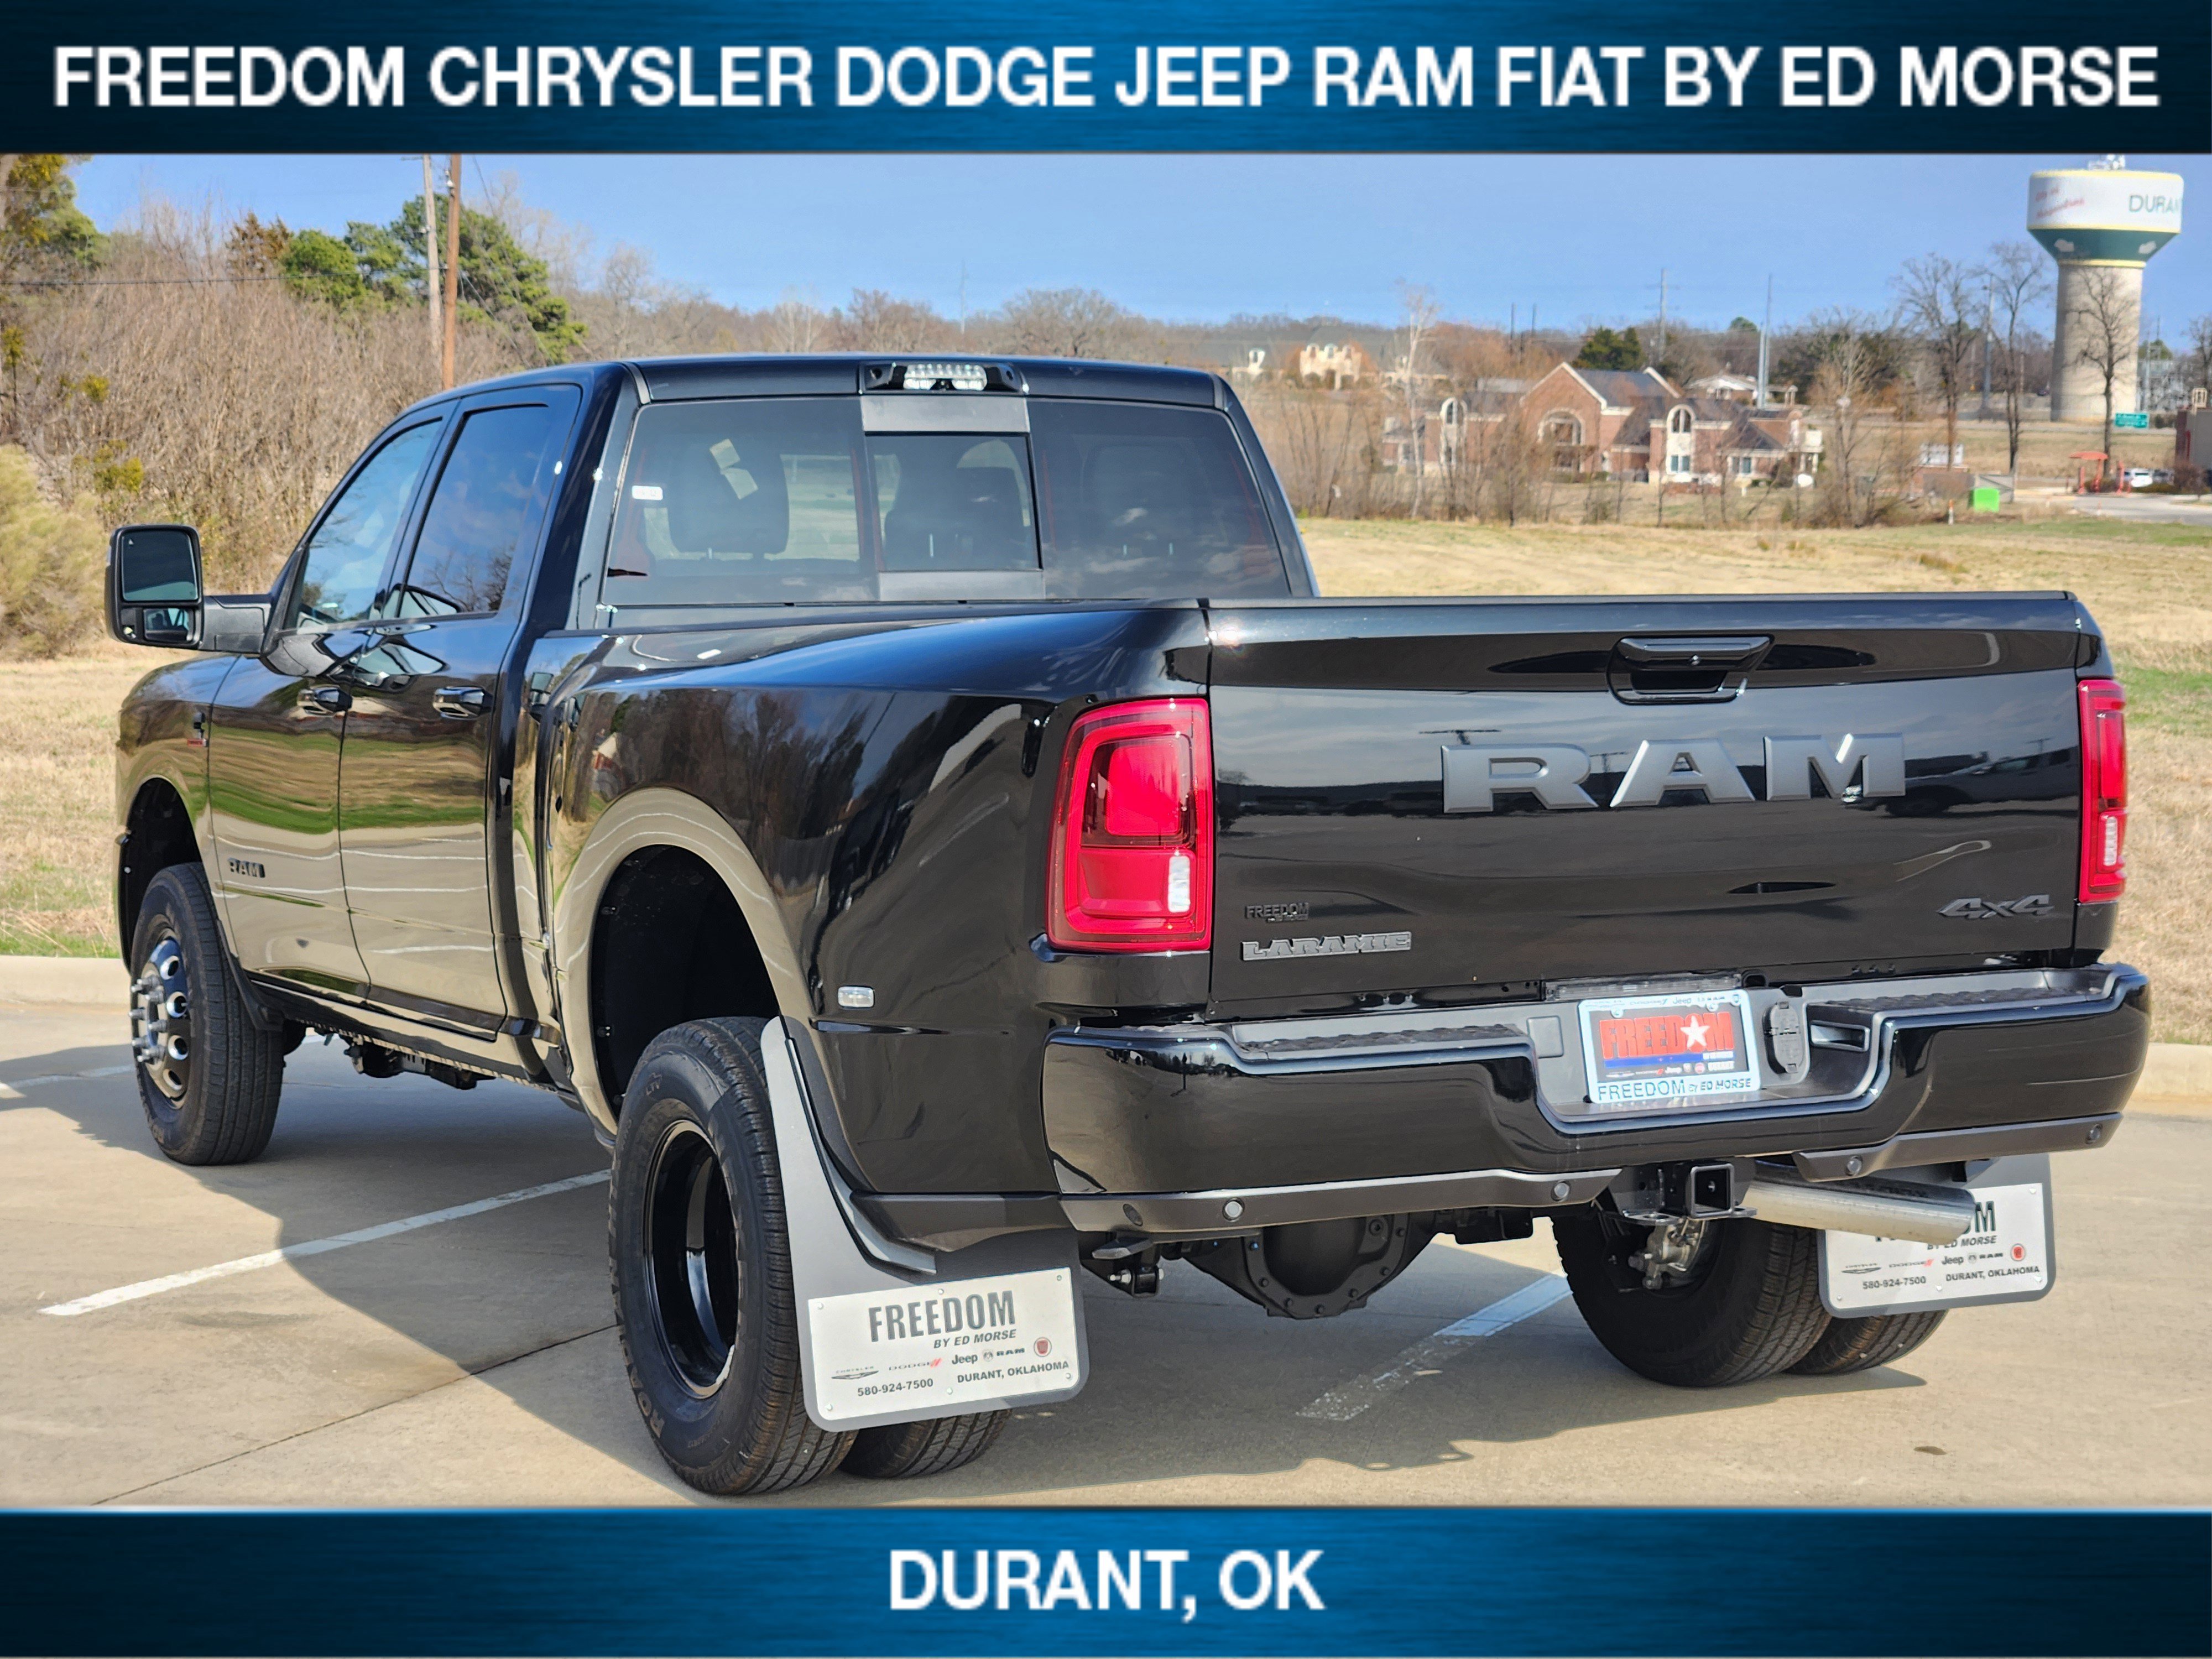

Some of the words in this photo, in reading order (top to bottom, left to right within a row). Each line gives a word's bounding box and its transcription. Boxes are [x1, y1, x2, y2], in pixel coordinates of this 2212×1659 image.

[1441, 733, 1907, 813] RAM
[227, 857, 265, 878] RAM
[1244, 902, 1309, 919] FREEDOM
[1240, 931, 1412, 961] LARAMIE
[1599, 1011, 1735, 1060] FREEDOM
[1598, 1079, 1686, 1100] FREEDOM
[1700, 1081, 1713, 1091] ED
[1715, 1078, 1751, 1090] MORSE
[1960, 1235, 1997, 1247] MORSE
[1941, 1256, 1964, 1265] Jeep
[1863, 1276, 1927, 1290] 580-924-7500
[1946, 1271, 1985, 1281] DURANT,
[1988, 1265, 2040, 1277] OKLAHOMA
[868, 1290, 1016, 1343] FREEDOM
[933, 1337, 950, 1349] BY
[954, 1335, 970, 1346] ED
[974, 1329, 1017, 1344] MORSE
[952, 1354, 978, 1365] Jeep
[857, 1378, 934, 1396] 580-924-7500
[957, 1369, 1004, 1383] DURANT,
[1007, 1360, 1070, 1376] OKLAHOMA
